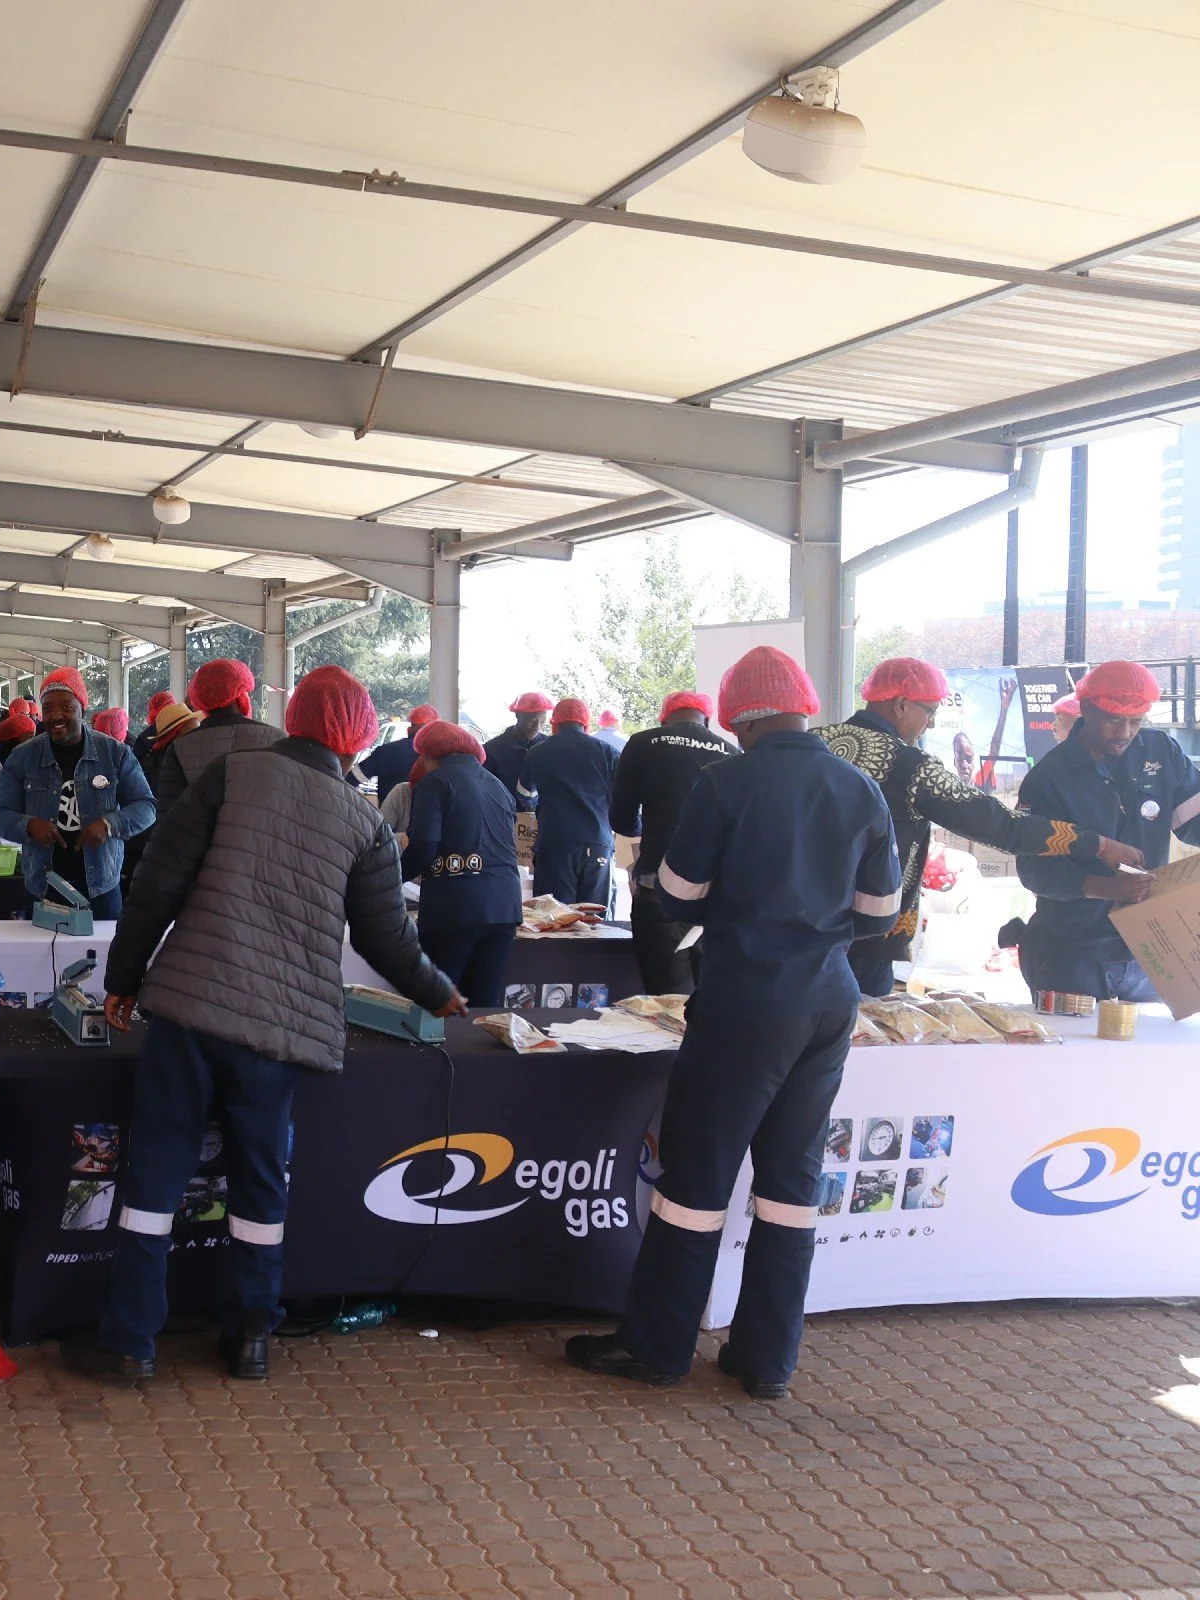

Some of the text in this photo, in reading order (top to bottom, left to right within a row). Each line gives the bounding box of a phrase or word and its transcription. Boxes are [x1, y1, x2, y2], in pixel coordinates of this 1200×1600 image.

[1024, 684, 1057, 693] TOGETHER
[1026, 694, 1051, 702] WE CAN
[1027, 704, 1040, 712] END
[661, 735, 690, 743] STARTS
[515, 1149, 617, 1200] egoli
[564, 1197, 629, 1237] gas
[46, 1250, 115, 1263] PIPED NATUR
